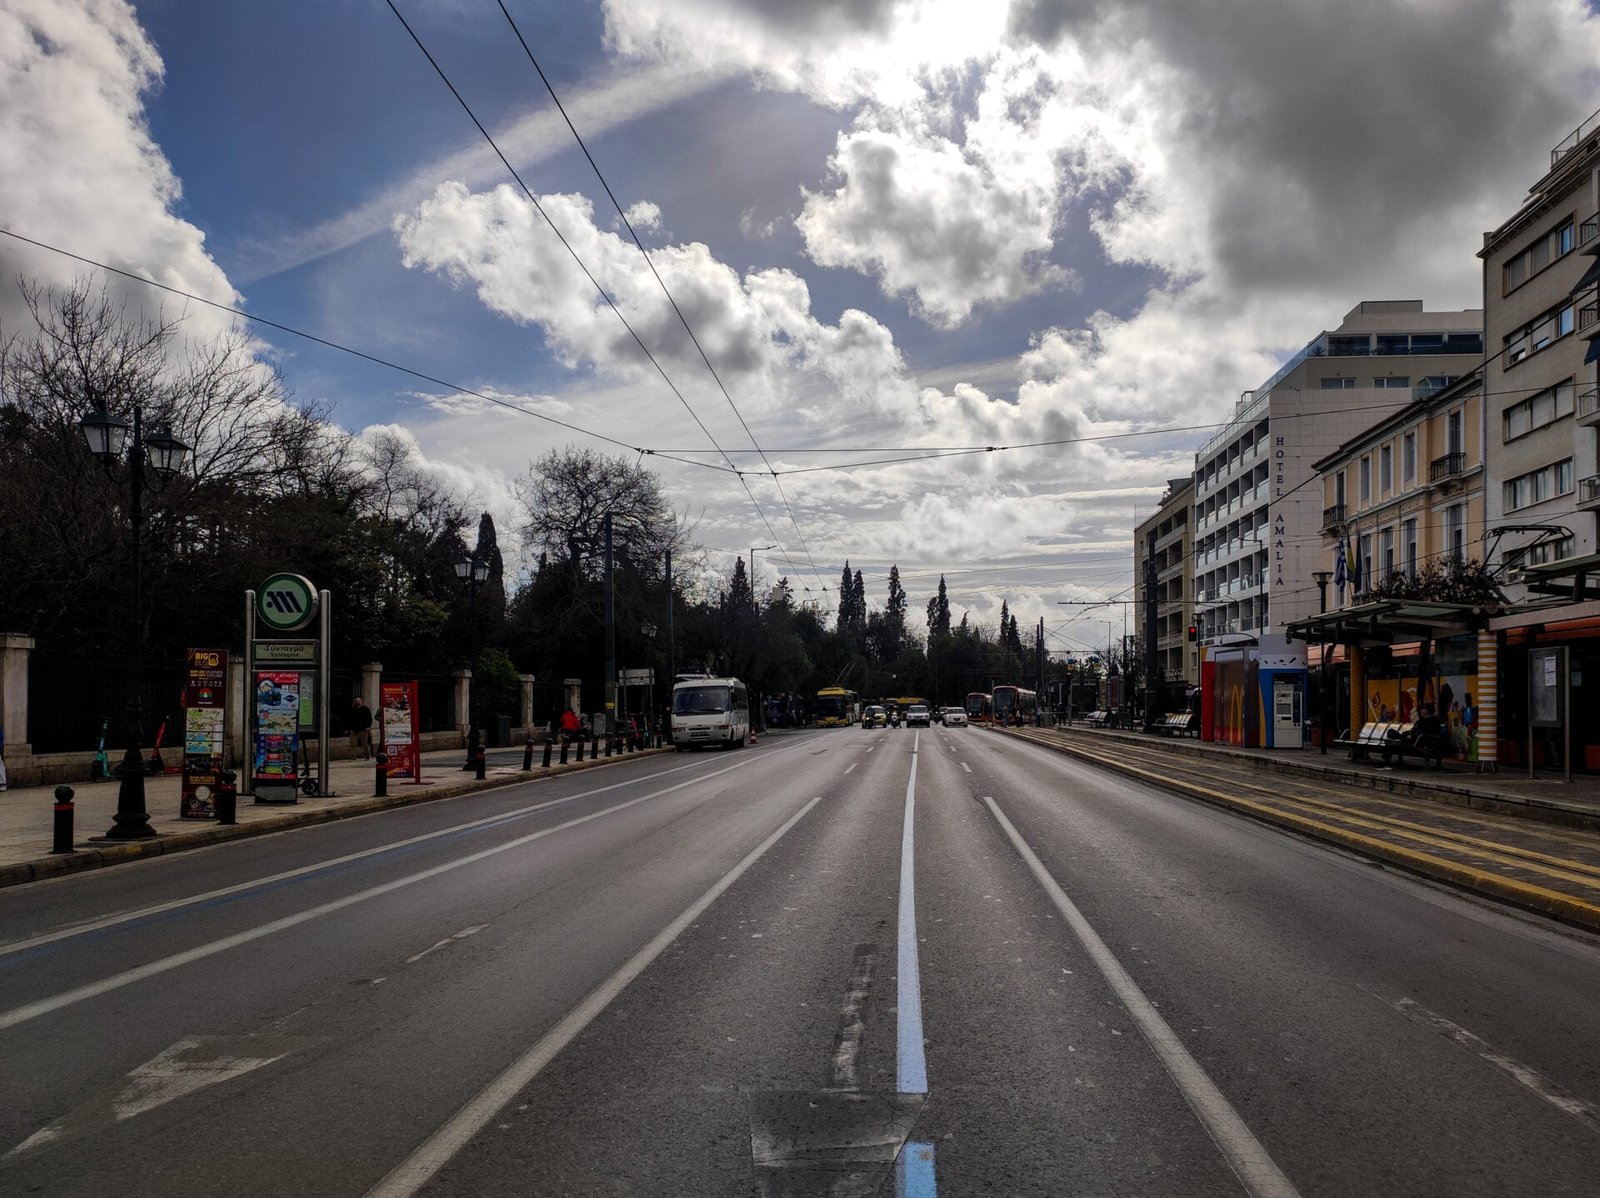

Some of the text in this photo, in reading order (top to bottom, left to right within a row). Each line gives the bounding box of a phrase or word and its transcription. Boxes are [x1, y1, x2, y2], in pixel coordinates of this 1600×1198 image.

[1275, 437, 1286, 586] HOTEL AMALIA
[266, 644, 304, 652] Σύνταγμα
[195, 652, 208, 660] BIG
